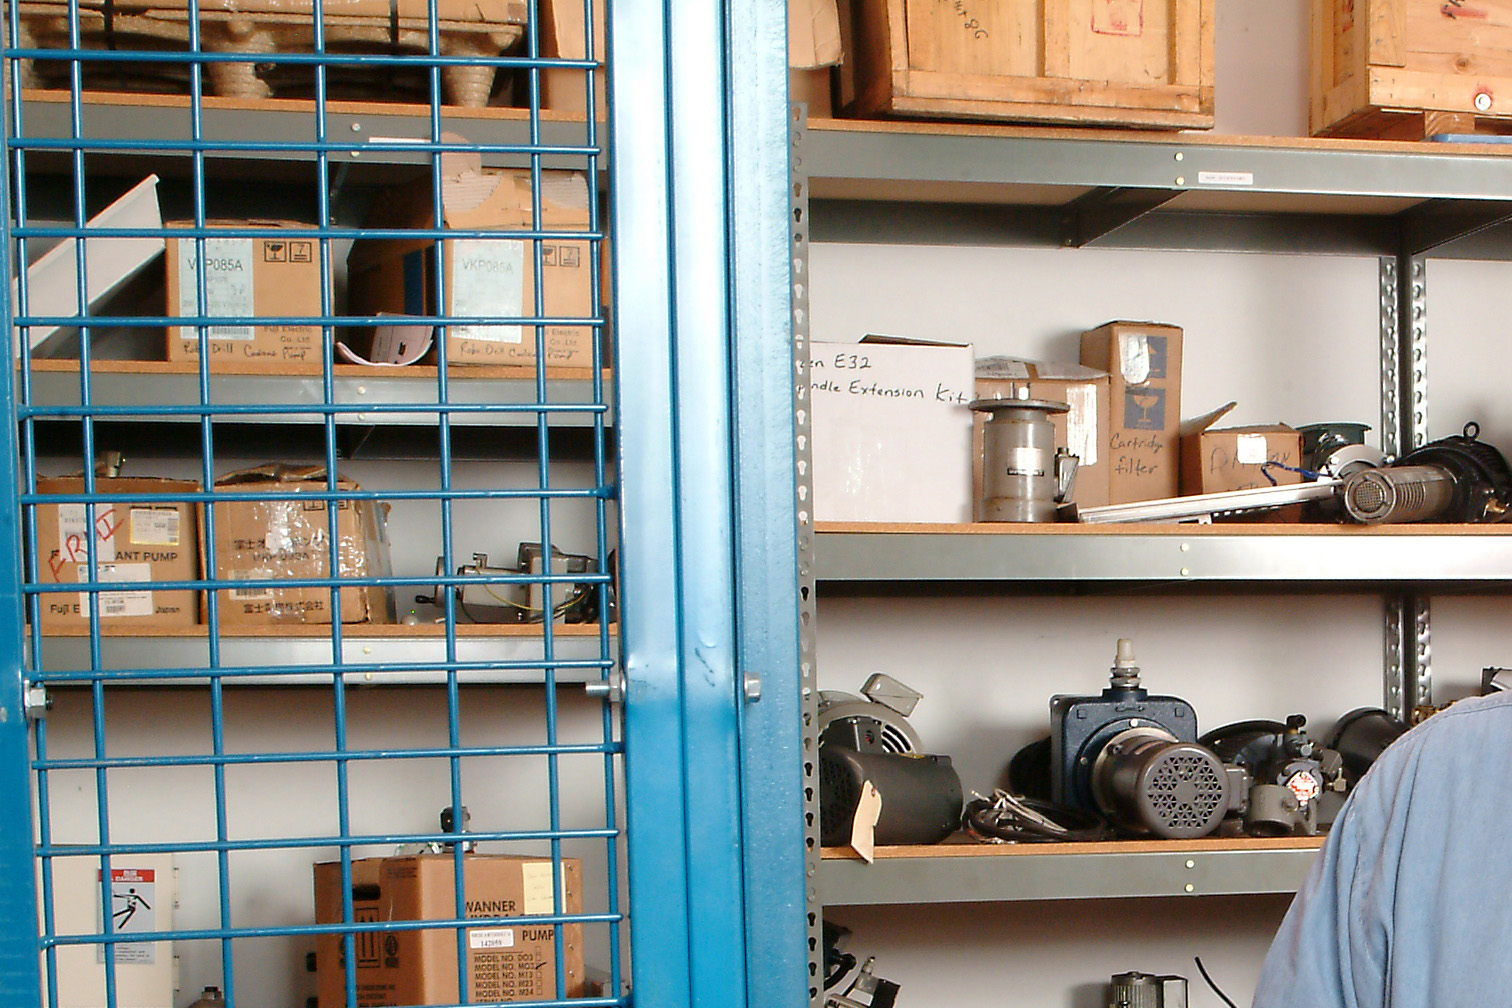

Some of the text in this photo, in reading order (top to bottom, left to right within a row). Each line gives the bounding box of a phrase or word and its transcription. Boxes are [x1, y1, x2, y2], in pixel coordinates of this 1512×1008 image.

[188, 258, 244, 271] VP085A
[834, 354, 873, 369] E32
[850, 380, 925, 399] Extension
[935, 383, 969, 404] Kit
[143, 552, 178, 561] PUMP
[51, 605, 69, 615] Fuji
[523, 930, 554, 941] PUMP
[474, 955, 499, 963] MODEL
[474, 963, 499, 971] MODEL
[475, 972, 499, 980] MODEL
[475, 980, 500, 988] MODEL
[475, 989, 500, 997] MODEL
